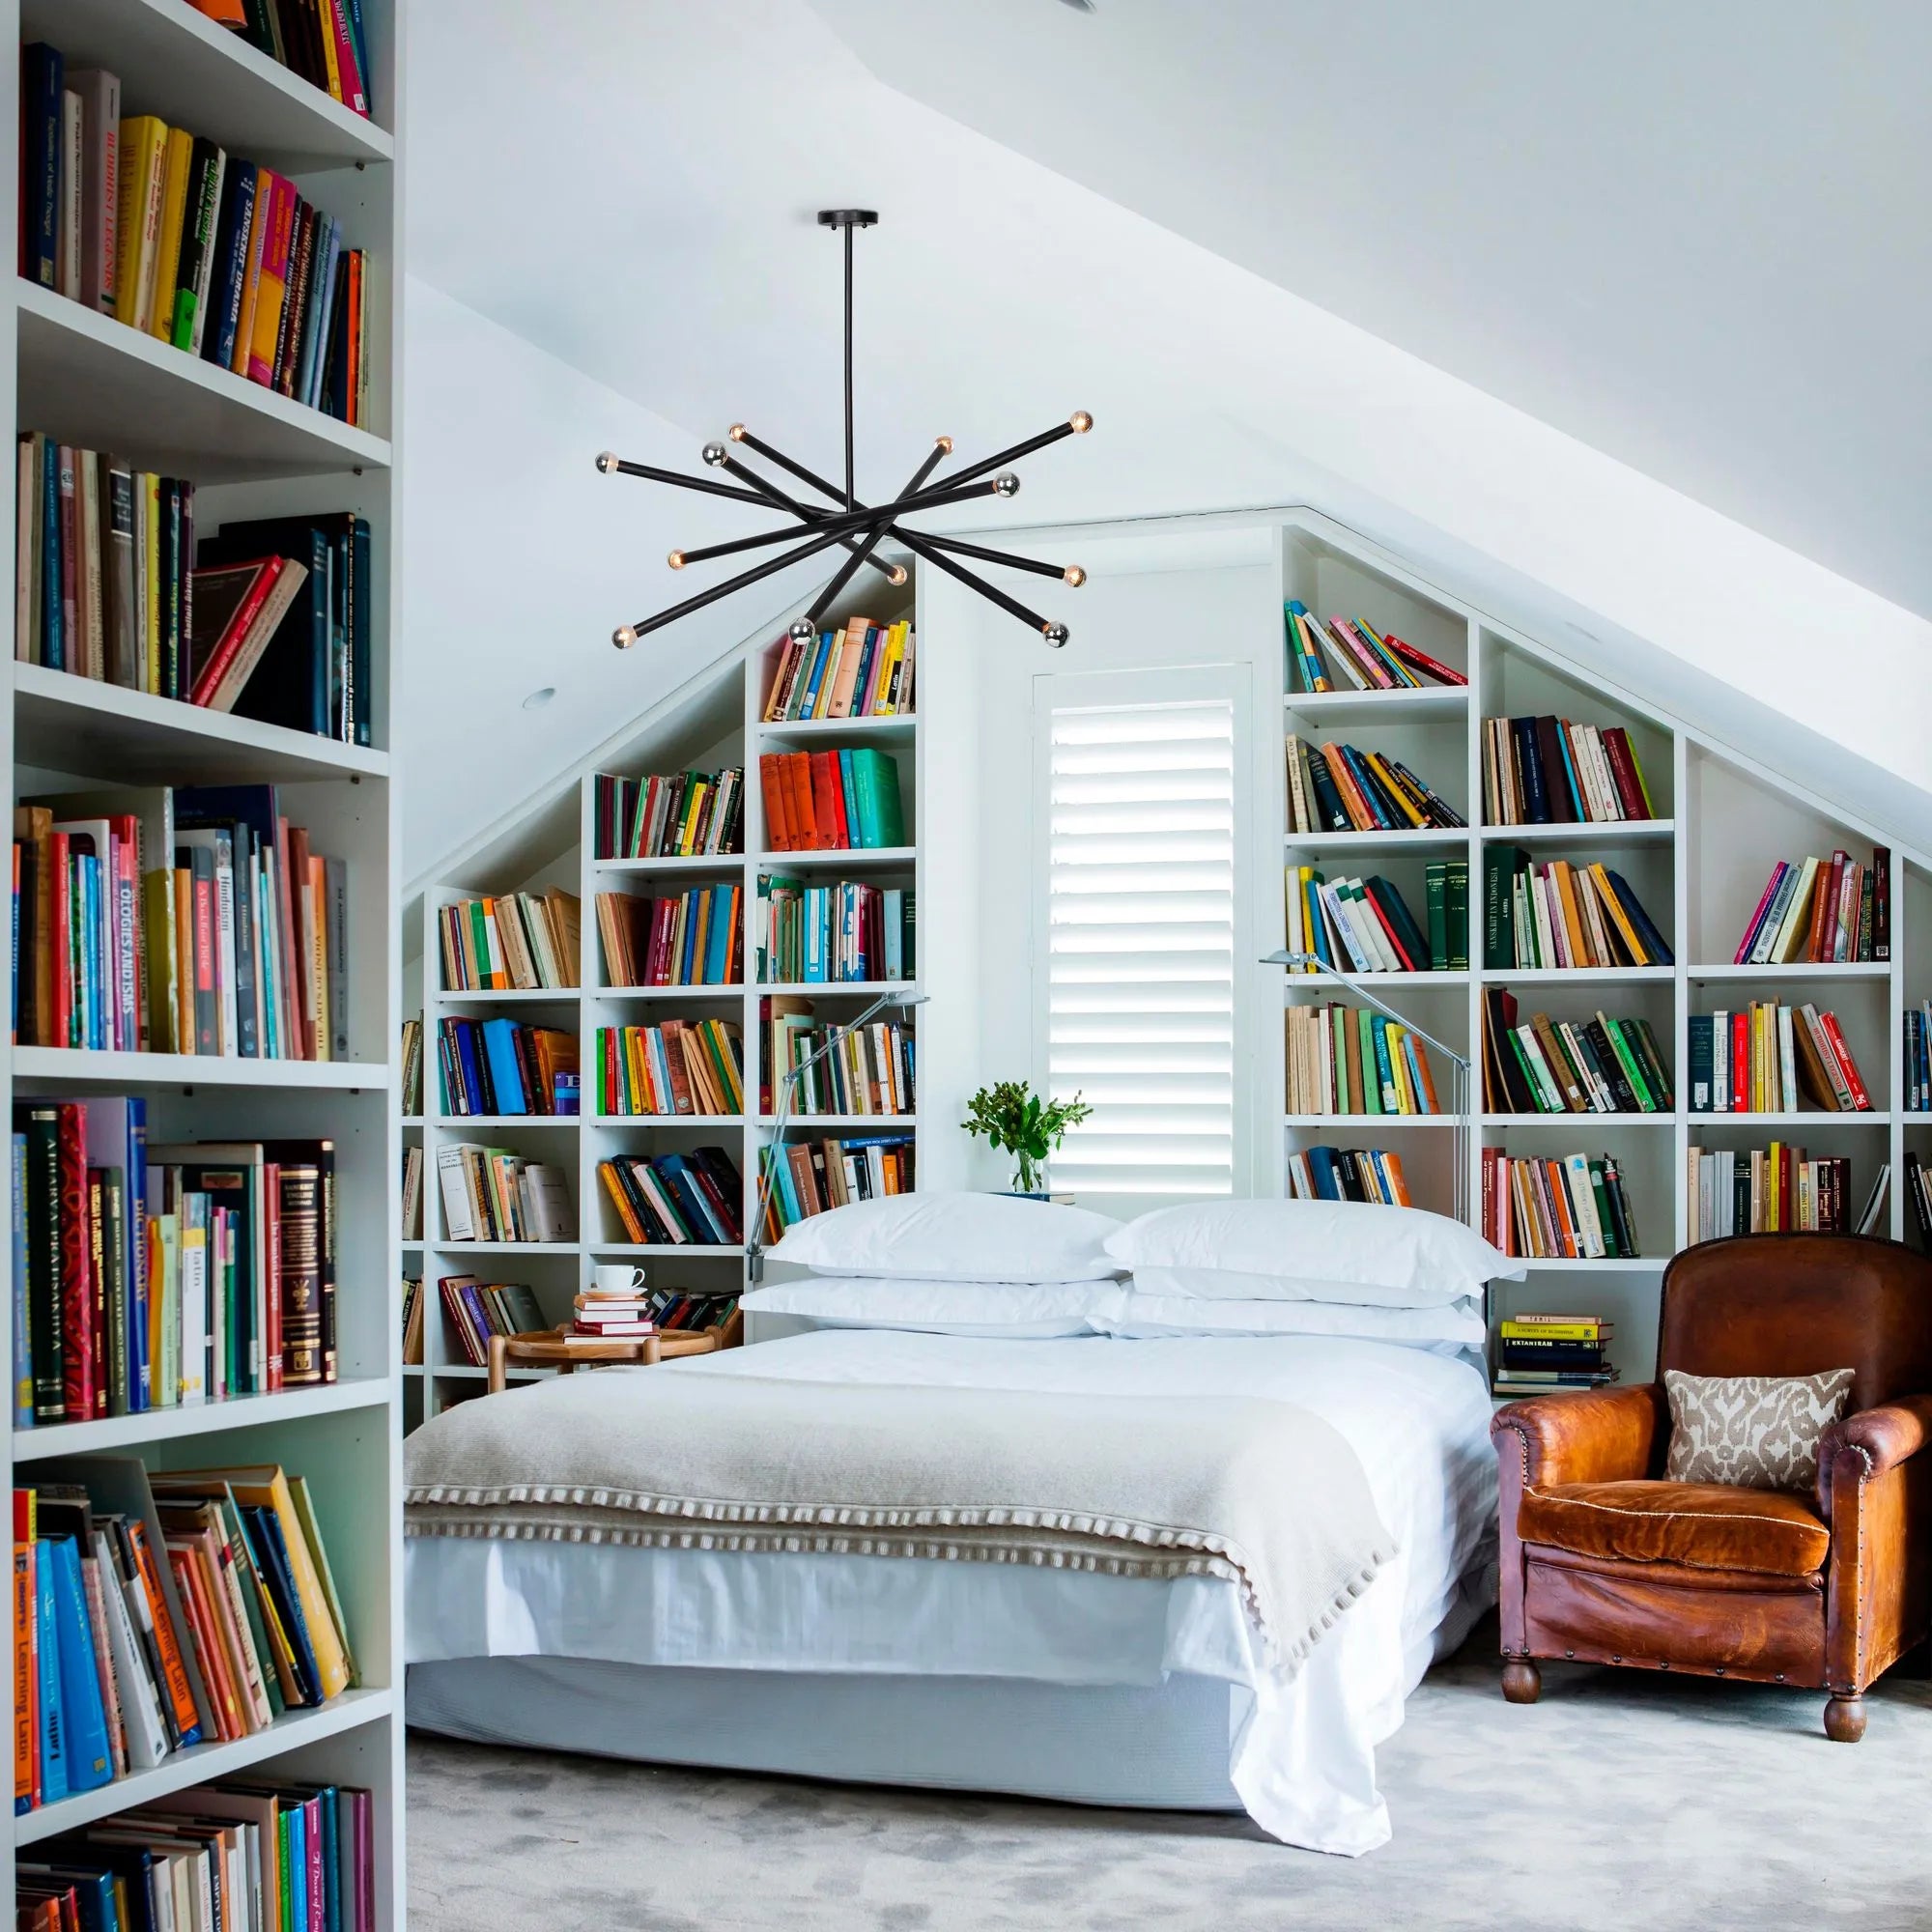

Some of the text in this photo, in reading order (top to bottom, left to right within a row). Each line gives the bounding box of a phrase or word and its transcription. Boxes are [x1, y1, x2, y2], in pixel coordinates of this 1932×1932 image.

[103, 131, 116, 290] BUDDHIST LEGENDS
[237, 198, 253, 269] SANSKRIT
[229, 271, 244, 324] DRAMA
[220, 876, 231, 931] Hinduism
[1490, 867, 1498, 904] INDONESIA
[120, 888, 134, 1014] OLOGIES AND ISMS
[1812, 1027, 1843, 1091] BUDDHIST LEGENDS
[46, 1138, 60, 1222] ATHARVA
[133, 1198, 147, 1302] DICTIONARY
[193, 1251, 202, 1287] latin
[15, 1641, 29, 1713] Learning
[156, 1601, 188, 1702] Learning Latin
[17, 1719, 30, 1761] Latin
[213, 1874, 221, 1914] EMPTY
[312, 1866, 321, 1896] Dose
